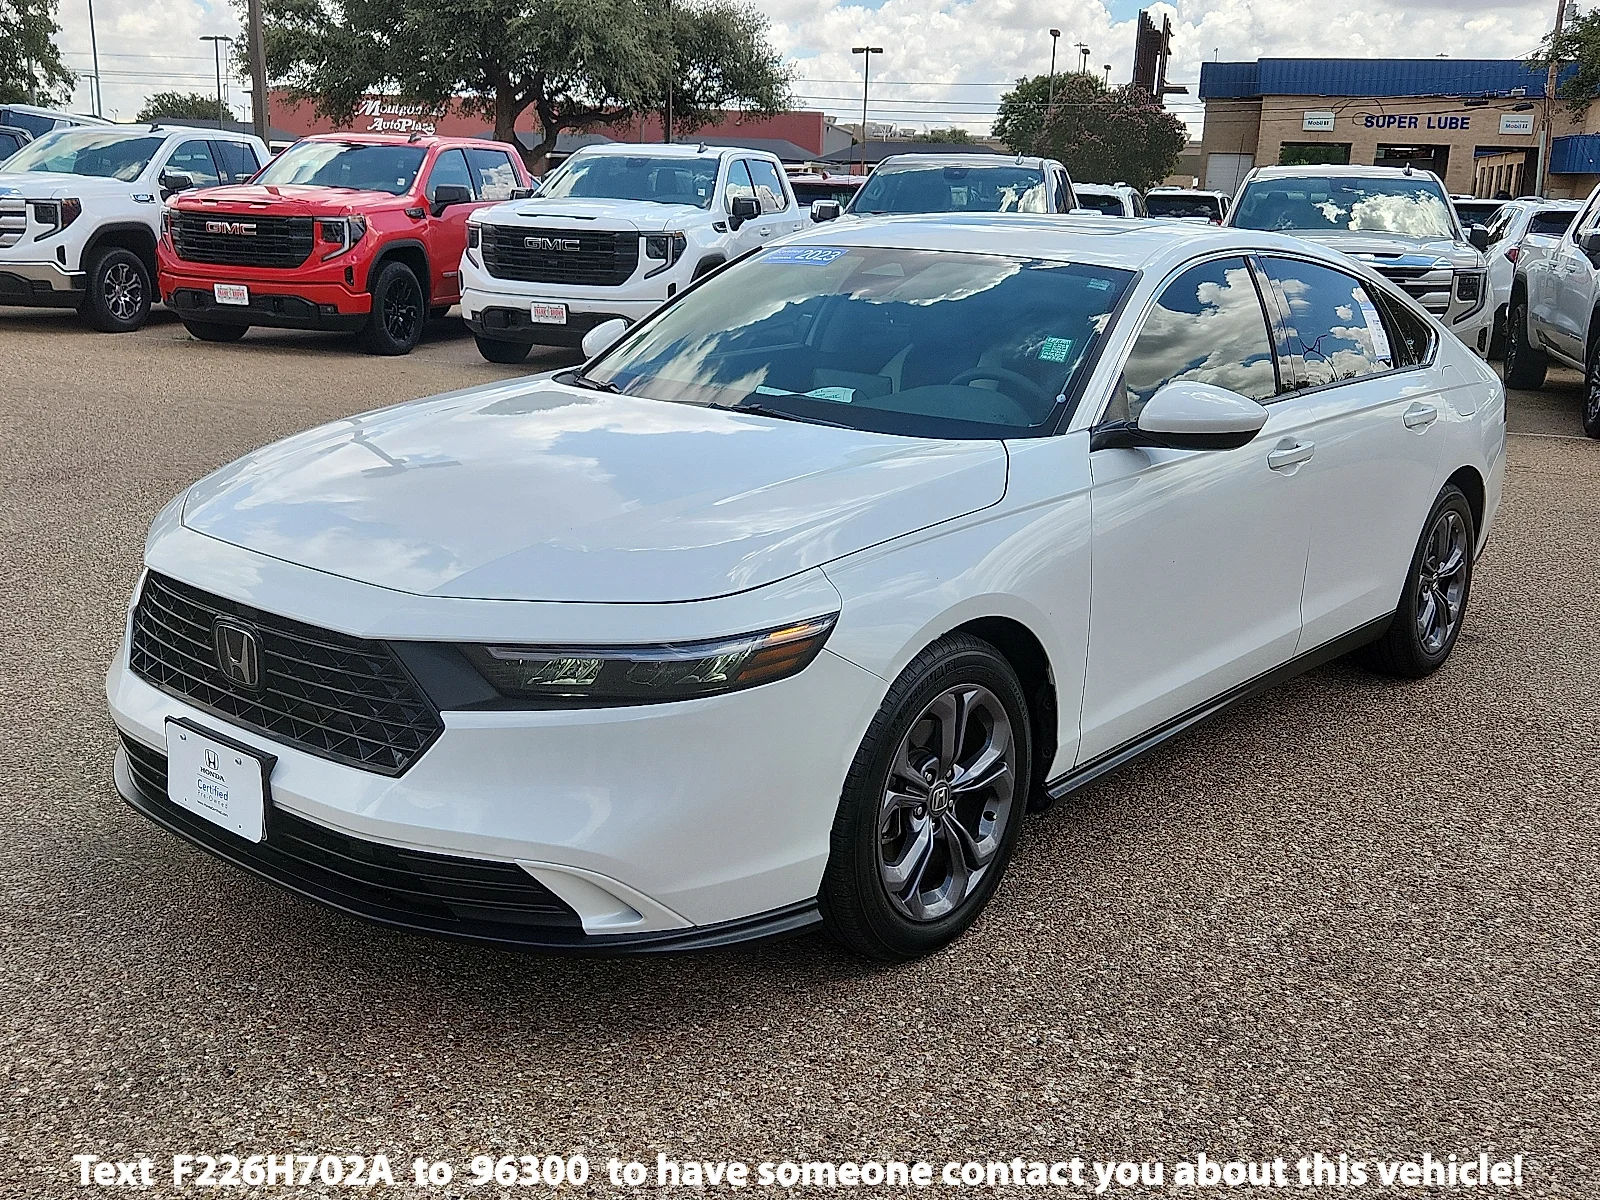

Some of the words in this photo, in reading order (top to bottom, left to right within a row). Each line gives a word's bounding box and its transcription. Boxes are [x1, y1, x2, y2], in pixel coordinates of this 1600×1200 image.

[366, 117, 436, 135] AutoPlaza
[1364, 115, 1419, 129] SUPER
[1426, 116, 1471, 130] LUBE
[205, 220, 257, 236] GMC
[523, 236, 580, 252] GMC
[795, 249, 842, 261] 2023
[200, 765, 226, 783] HONDA
[197, 778, 229, 801] Certified
